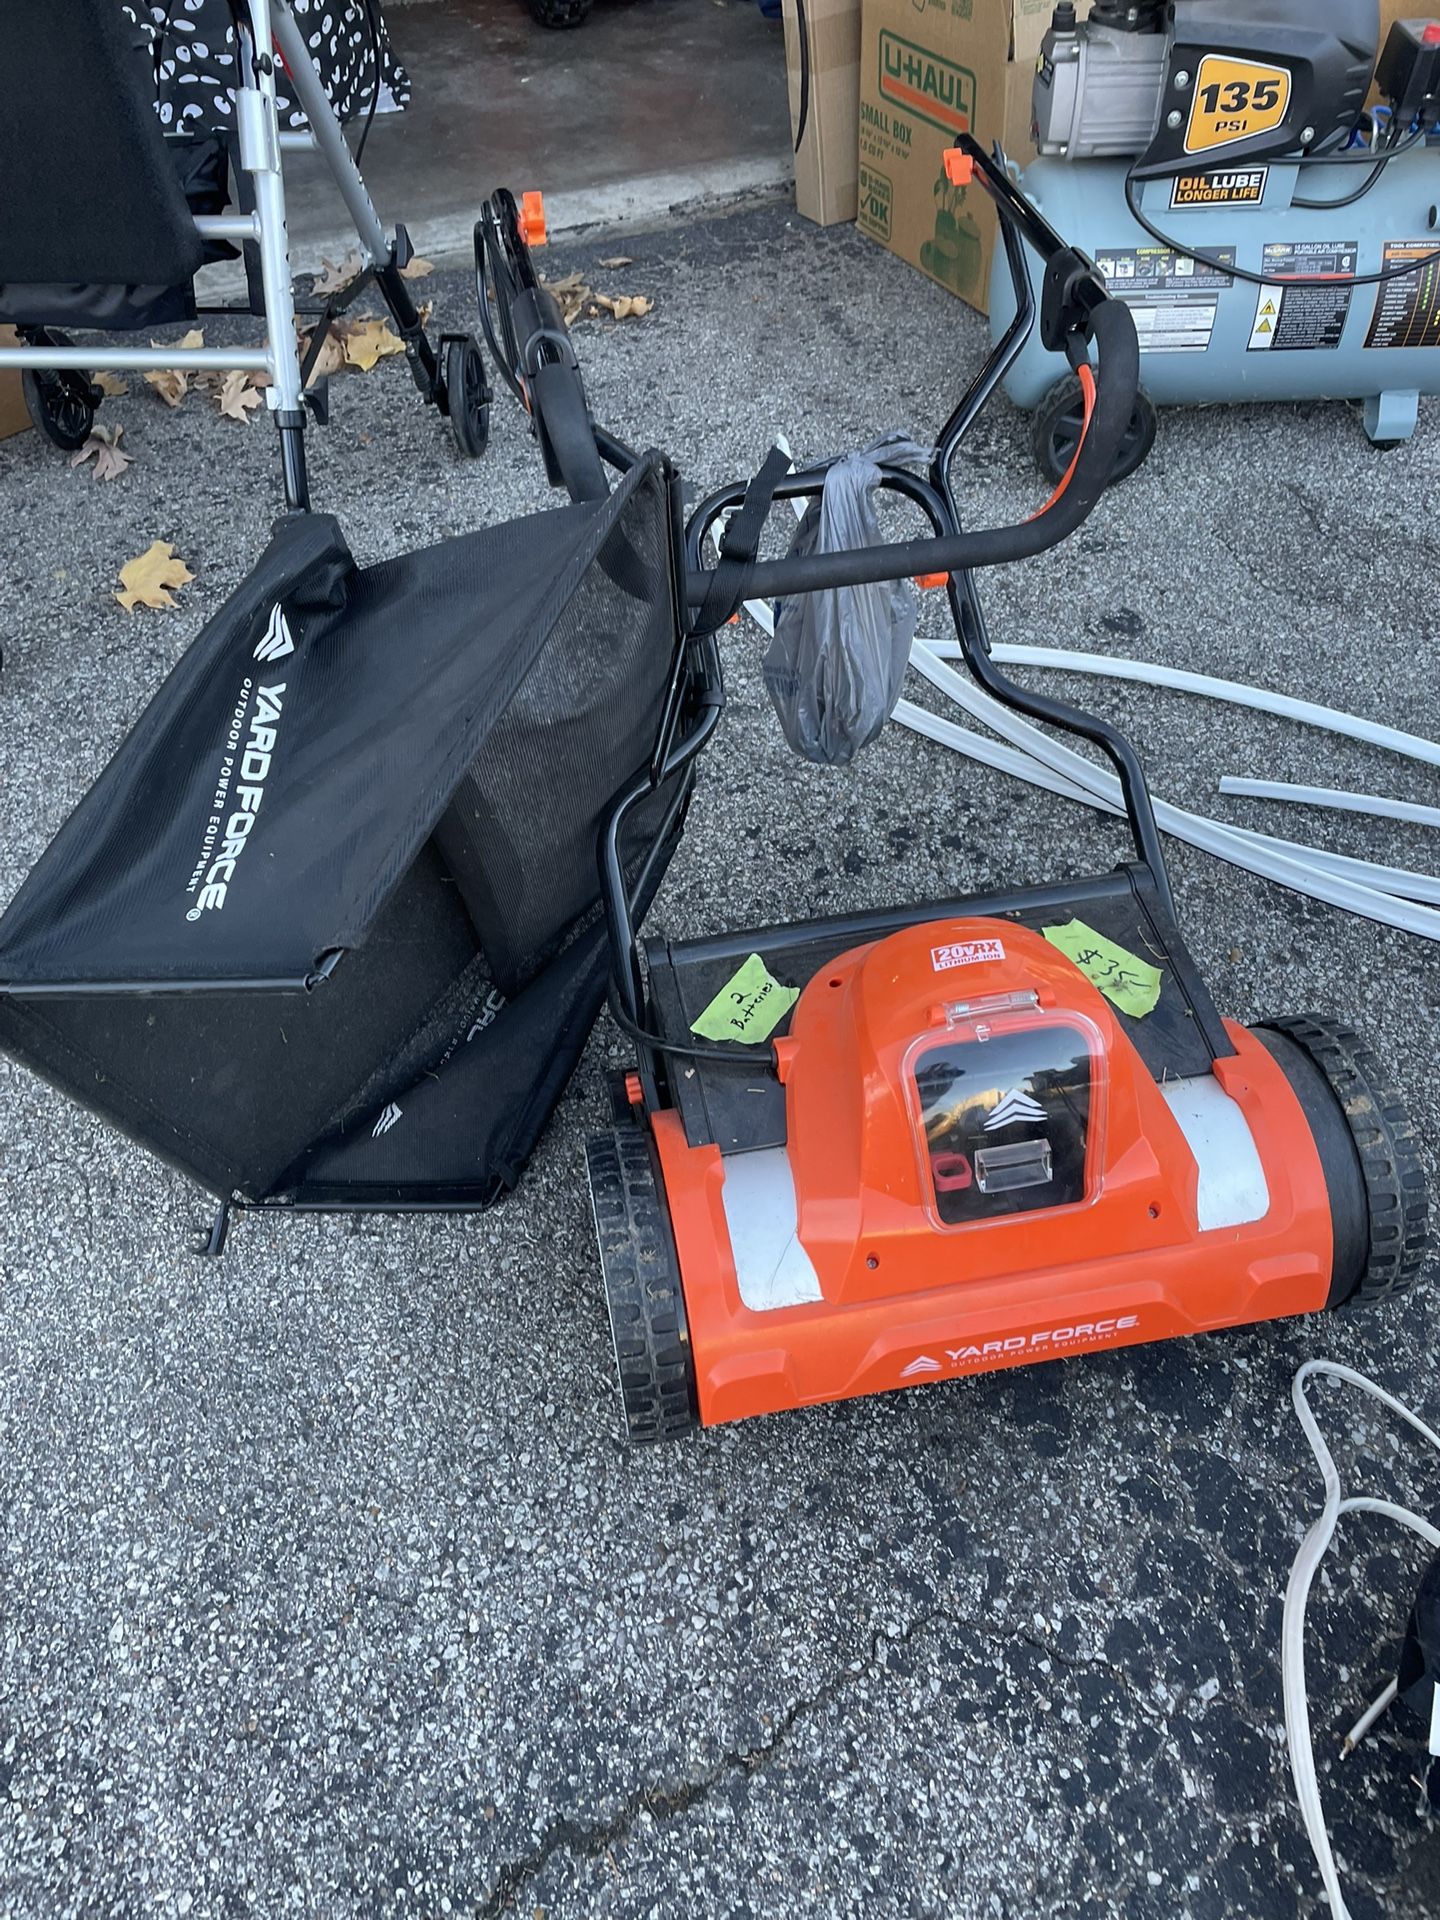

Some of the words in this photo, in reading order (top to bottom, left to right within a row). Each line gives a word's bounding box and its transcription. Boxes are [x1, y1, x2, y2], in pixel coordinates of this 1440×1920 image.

[885, 42, 968, 113] U-HAUL
[1200, 79, 1281, 114] 135
[860, 101, 889, 134] SMALL
[893, 119, 912, 147] BOX
[1215, 120, 1247, 133] PSI
[1176, 188, 1228, 202] LONGER
[1231, 185, 1259, 199] LIFE
[1179, 176, 1210, 191] OIL
[1212, 173, 1262, 189] LUBE
[870, 196, 888, 225] OK
[226, 677, 252, 751] OUTDOOR
[240, 682, 287, 781] YARD
[213, 756, 234, 809] POWER
[186, 816, 221, 893] EQUIPMENT
[939, 953, 1001, 969] LITHIUM-ION
[1076, 949, 1152, 988] $35
[730, 992, 752, 1005] 2
[945, 1336, 1026, 1360] YARD
[1031, 1315, 1138, 1346] FORCE
[951, 1352, 1004, 1368] OUTDOOR
[1010, 1345, 1048, 1358] POWER
[1054, 1332, 1118, 1349] EQUIPMENT
